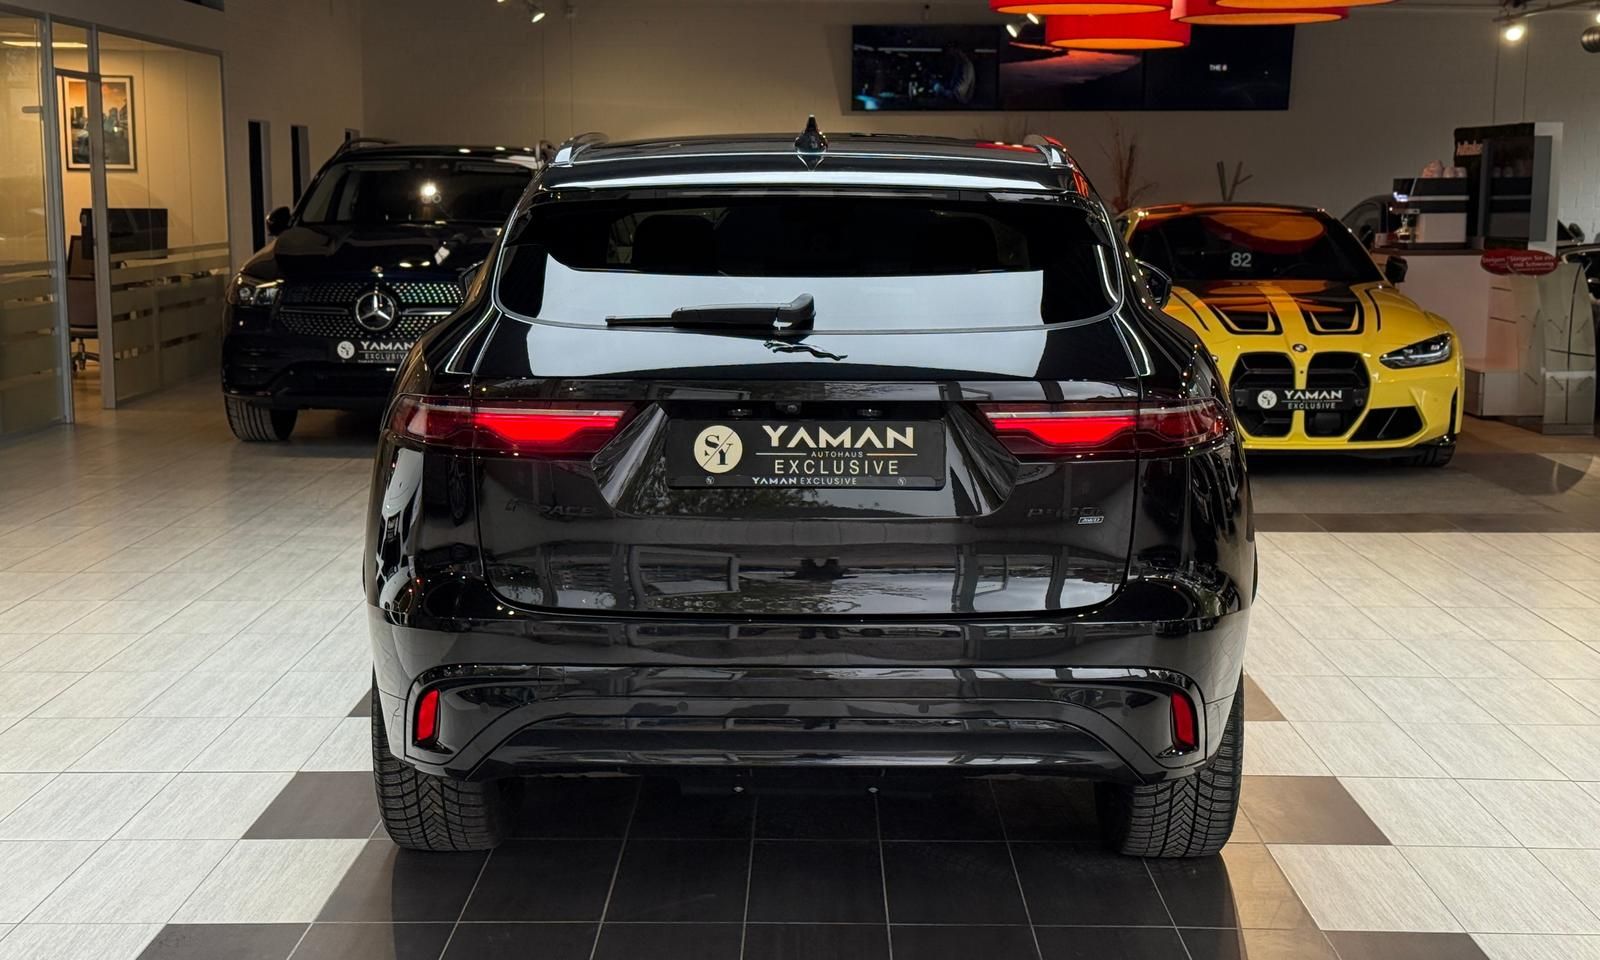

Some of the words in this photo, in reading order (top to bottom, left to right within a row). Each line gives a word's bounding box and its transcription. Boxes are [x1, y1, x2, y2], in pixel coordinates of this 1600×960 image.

[1231, 252, 1251, 267] 82
[360, 341, 414, 350] YAMAN
[1284, 389, 1342, 400] YAMAN
[1287, 402, 1336, 410] EXCLUSIVE
[762, 425, 914, 449] YAMAN
[774, 459, 899, 475] EXCLUSIVE
[752, 476, 797, 485] YAMAN
[800, 477, 857, 485] EXCLUSIVE
